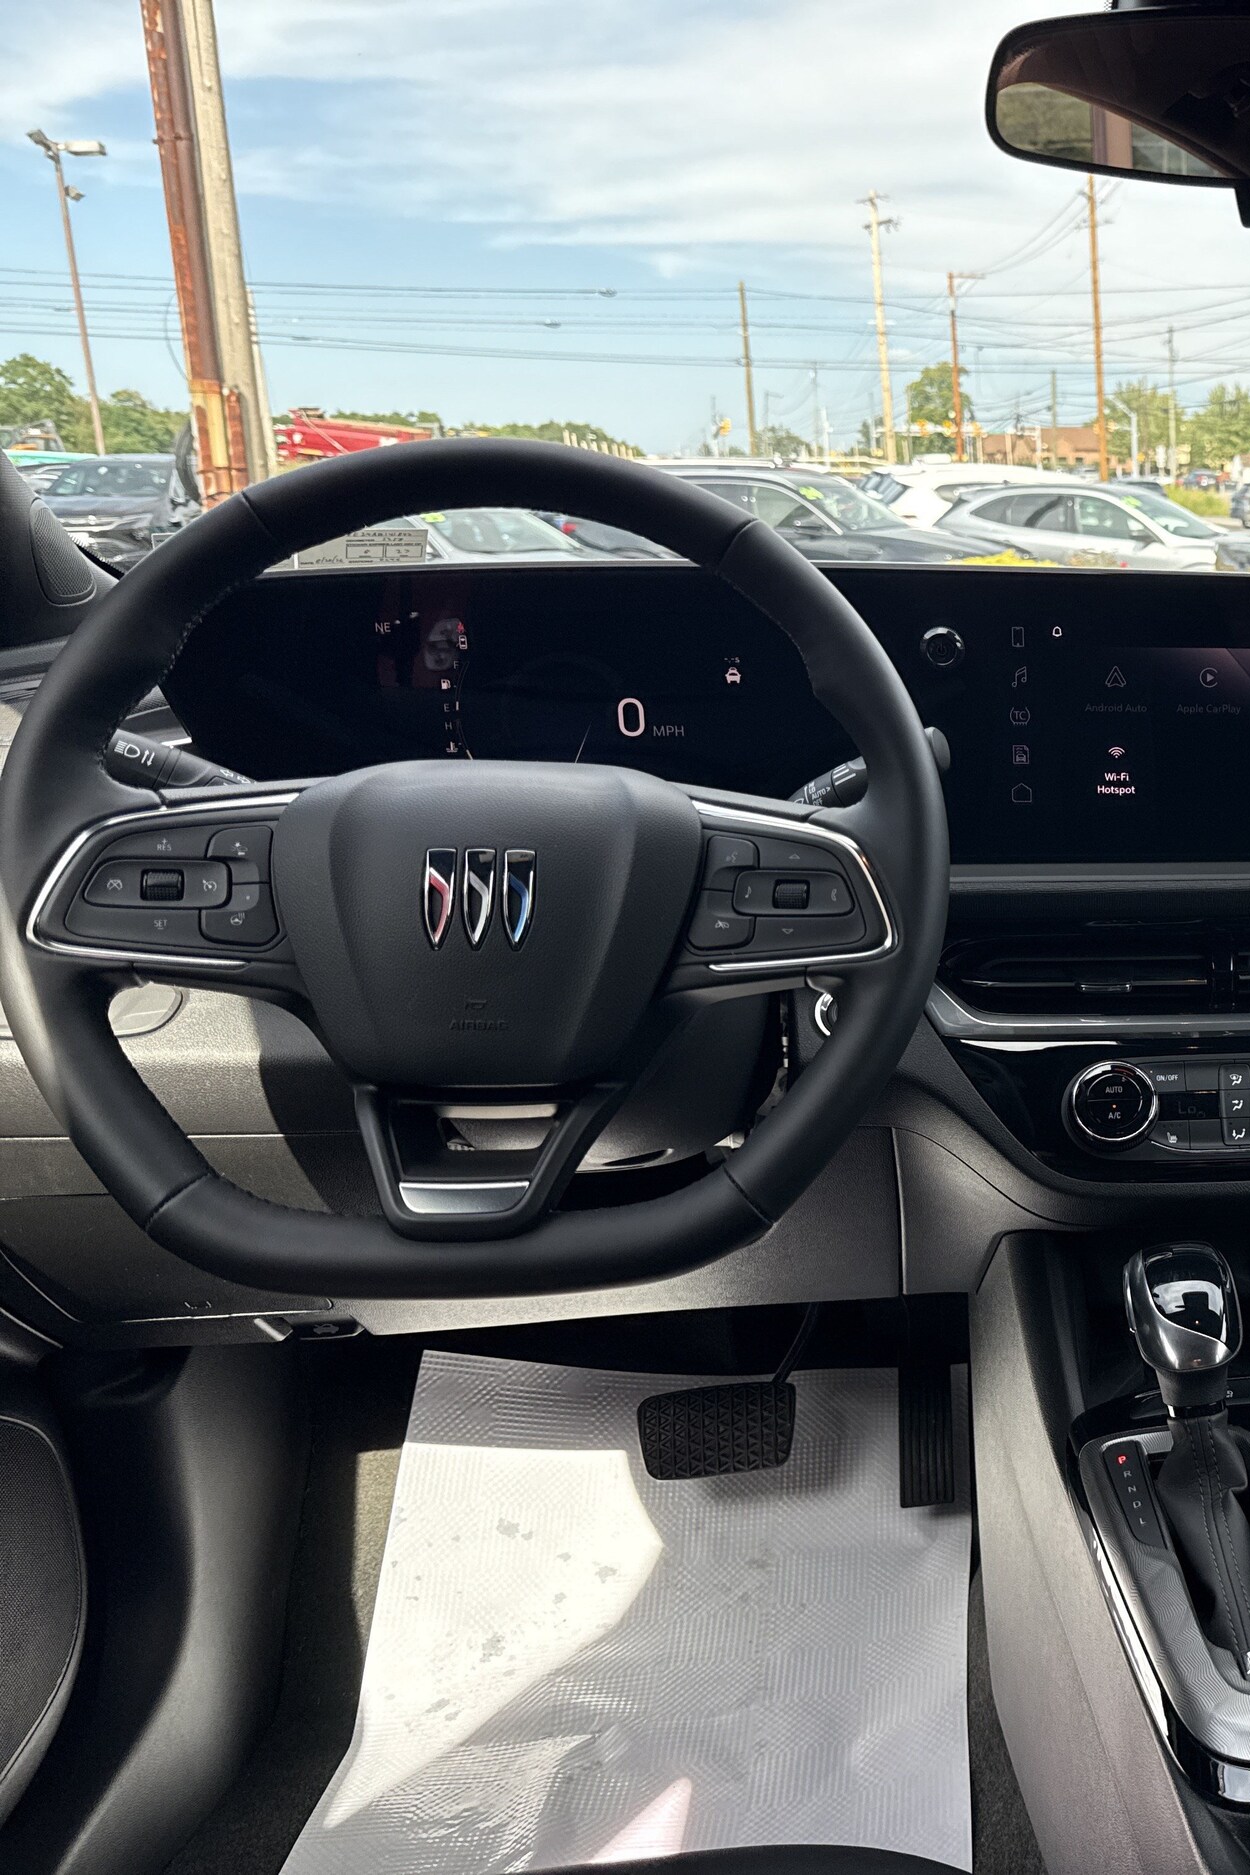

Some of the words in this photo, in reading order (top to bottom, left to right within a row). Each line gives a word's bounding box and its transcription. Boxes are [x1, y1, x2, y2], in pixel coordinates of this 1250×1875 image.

[374, 622, 391, 633] NE
[453, 661, 460, 669] F
[443, 703, 450, 712] E
[1085, 703, 1123, 713] Android
[1125, 703, 1148, 713] Auto
[1176, 703, 1203, 715] Apple
[1206, 703, 1241, 714] CarPlay
[617, 697, 646, 737] 0
[652, 725, 685, 737] MPH
[1014, 710, 1027, 720] TC
[444, 722, 453, 730] H
[1104, 772, 1130, 782] Wi-Fi
[811, 788, 826, 800] AUTO
[1096, 785, 1136, 795] Hotspot
[156, 844, 172, 852] RES
[153, 919, 168, 927] SET
[1155, 1074, 1179, 1083] ON/OFF
[1105, 1085, 1123, 1094] AUTO
[1108, 1111, 1121, 1120] A/C
[1117, 1455, 1127, 1465] P
[1123, 1470, 1132, 1478] R
[1127, 1484, 1137, 1493] N
[1132, 1500, 1142, 1509] D
[1139, 1517, 1147, 1525] L
